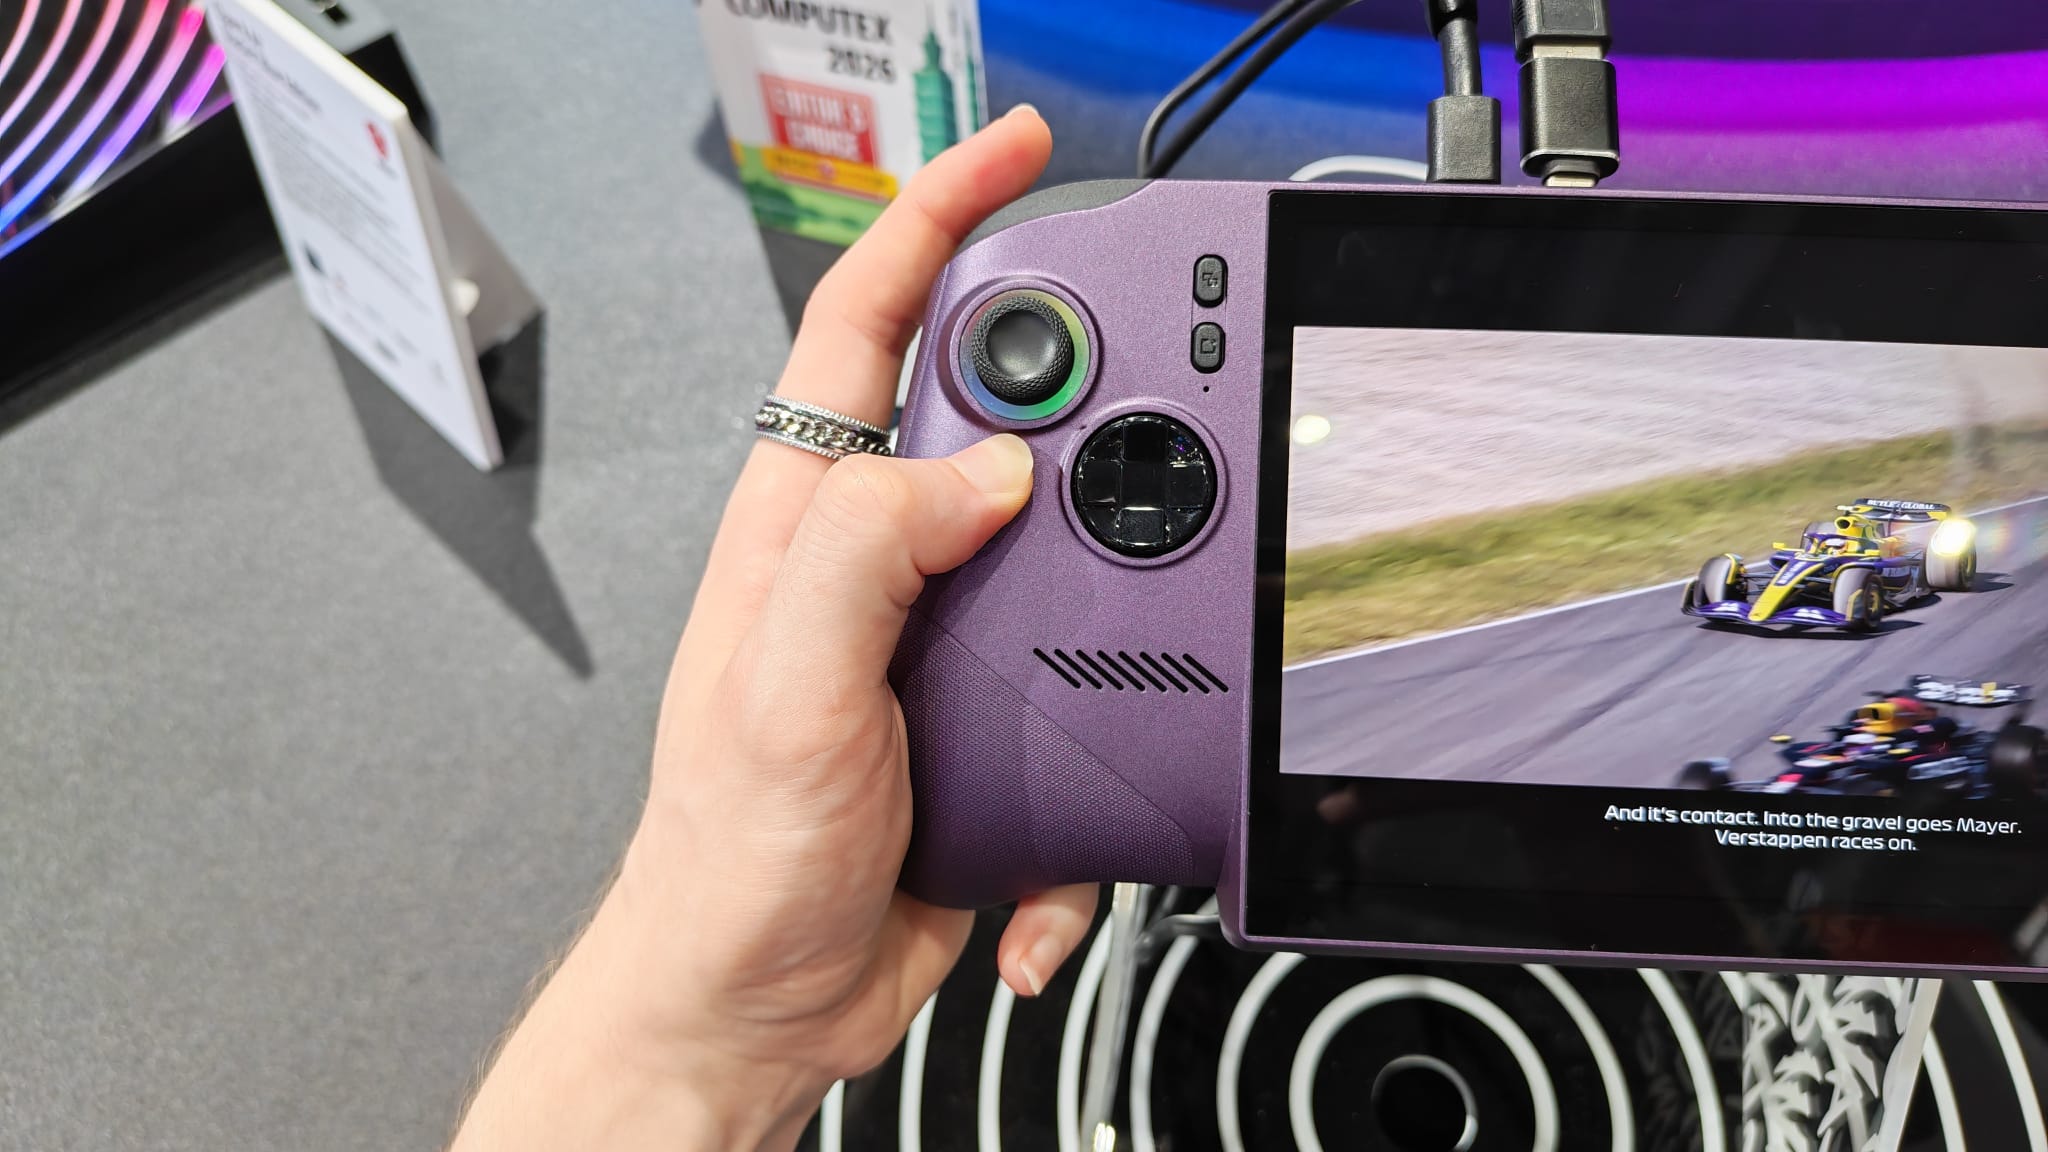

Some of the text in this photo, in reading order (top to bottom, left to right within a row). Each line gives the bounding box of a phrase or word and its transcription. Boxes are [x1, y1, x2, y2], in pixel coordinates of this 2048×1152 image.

[726, 0, 893, 45] COMPUTEX
[1901, 500, 1936, 510] GLOBAL
[1604, 804, 2023, 836] And it's contact. Into the gravel goes Mayer.
[1714, 829, 1917, 851] Verstappen races on.
